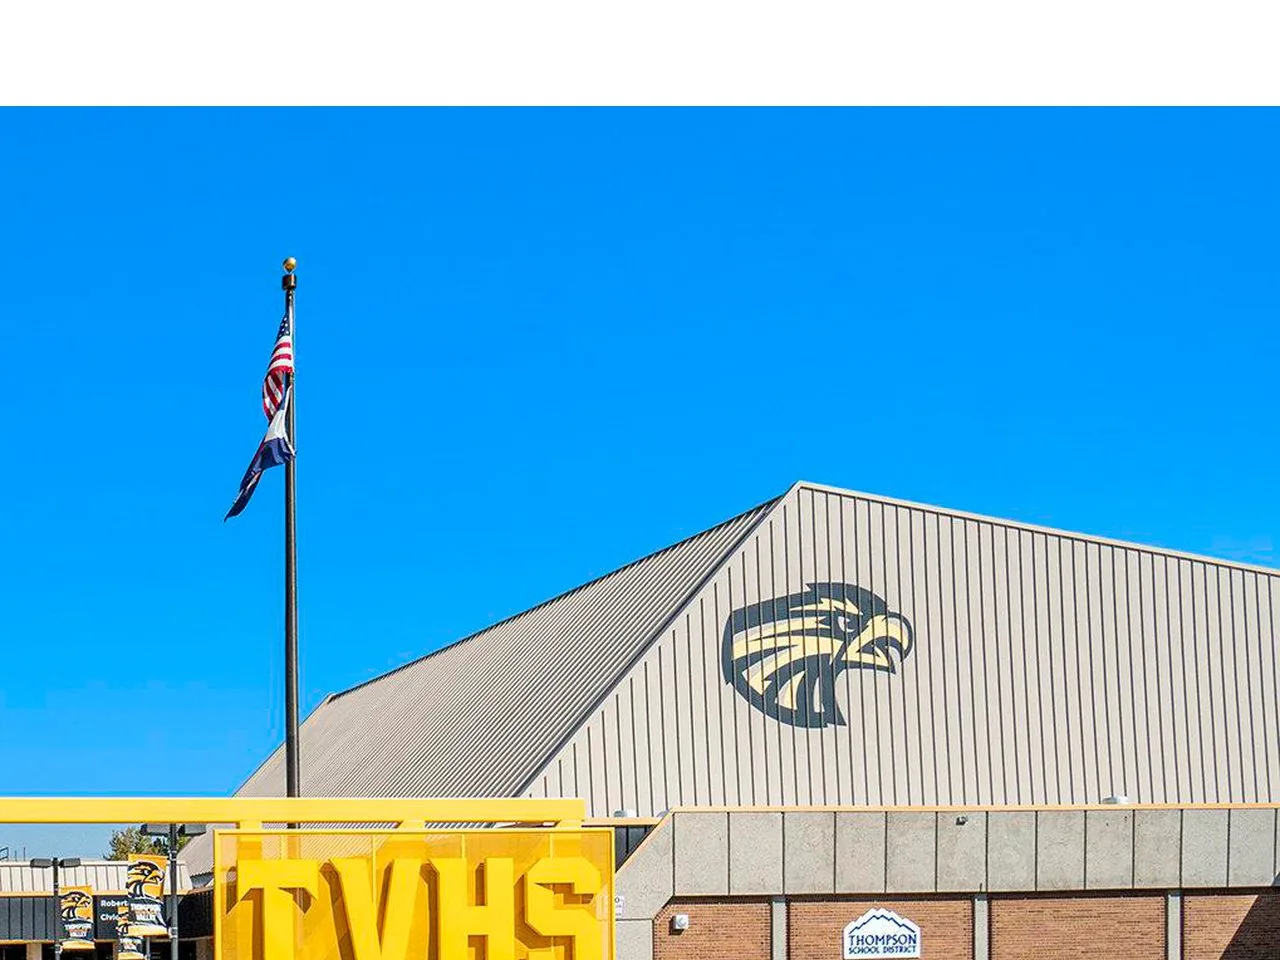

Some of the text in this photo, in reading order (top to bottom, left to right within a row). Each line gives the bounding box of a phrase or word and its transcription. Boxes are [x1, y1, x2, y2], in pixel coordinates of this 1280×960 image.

[848, 934, 917, 946] THOMPSON
[848, 946, 917, 954] SCHOOL DISTRICT
